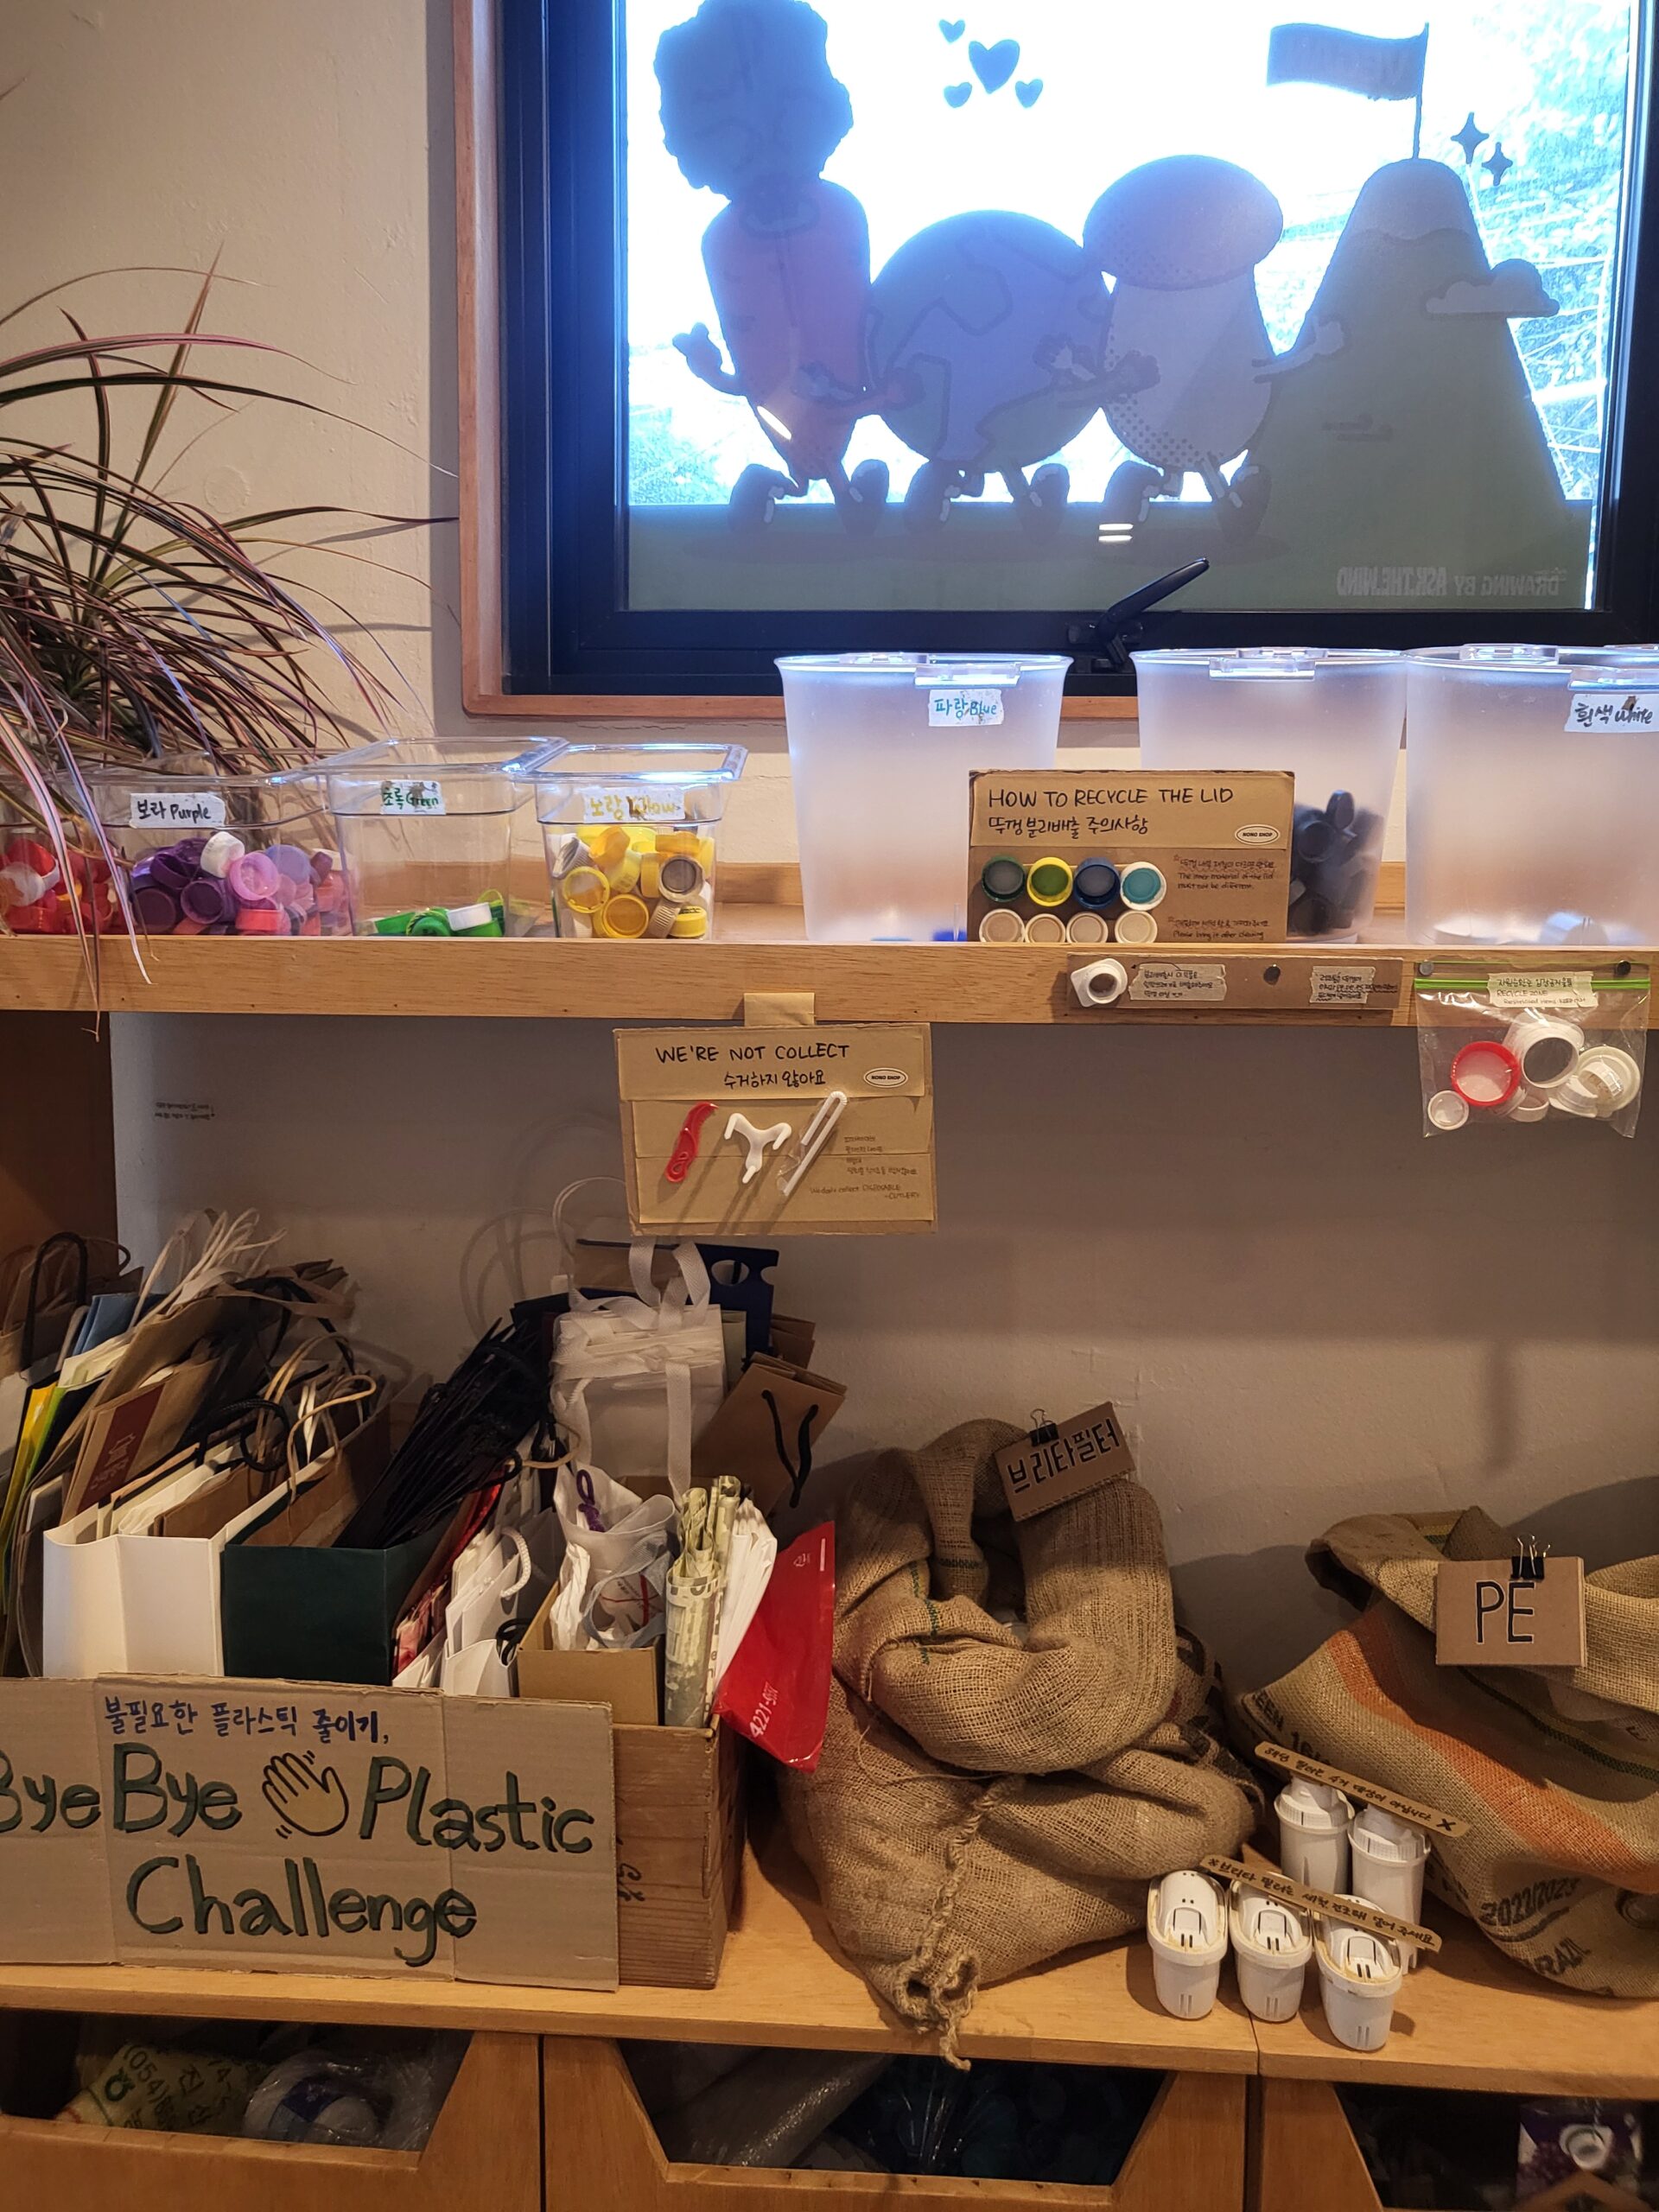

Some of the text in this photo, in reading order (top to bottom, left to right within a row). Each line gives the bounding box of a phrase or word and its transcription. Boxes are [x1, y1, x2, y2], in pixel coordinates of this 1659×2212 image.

[934, 698, 997, 719] 파랑 Blue
[1574, 702, 1613, 728] 흰색
[383, 787, 439, 810] 초록 Green
[988, 787, 1234, 808] HOW TO RECYCLE THE LID
[137, 799, 212, 823] 보라 Purple
[988, 814, 1149, 839] 뚜껑 분리배출 주의사항
[1173, 930, 1192, 938] Please
[1497, 989, 1528, 998] RECYCLE
[655, 1042, 850, 1064] WE'RE NOT COLLECT
[723, 1069, 826, 1090] 수거하지 않아요
[1007, 1418, 1120, 1494] 브리타필터
[1476, 1580, 1535, 1643] PE
[105, 1696, 390, 1744] 불필요한 플라스틱 줄이기,
[1264, 1746, 1291, 1763] 해당
[1327, 1775, 1348, 1787] 수거
[1352, 1783, 1388, 1802] 대상이
[112, 1743, 243, 1838] Bye
[359, 1756, 594, 1854] Plastic
[125, 1853, 478, 1967] Challenge
